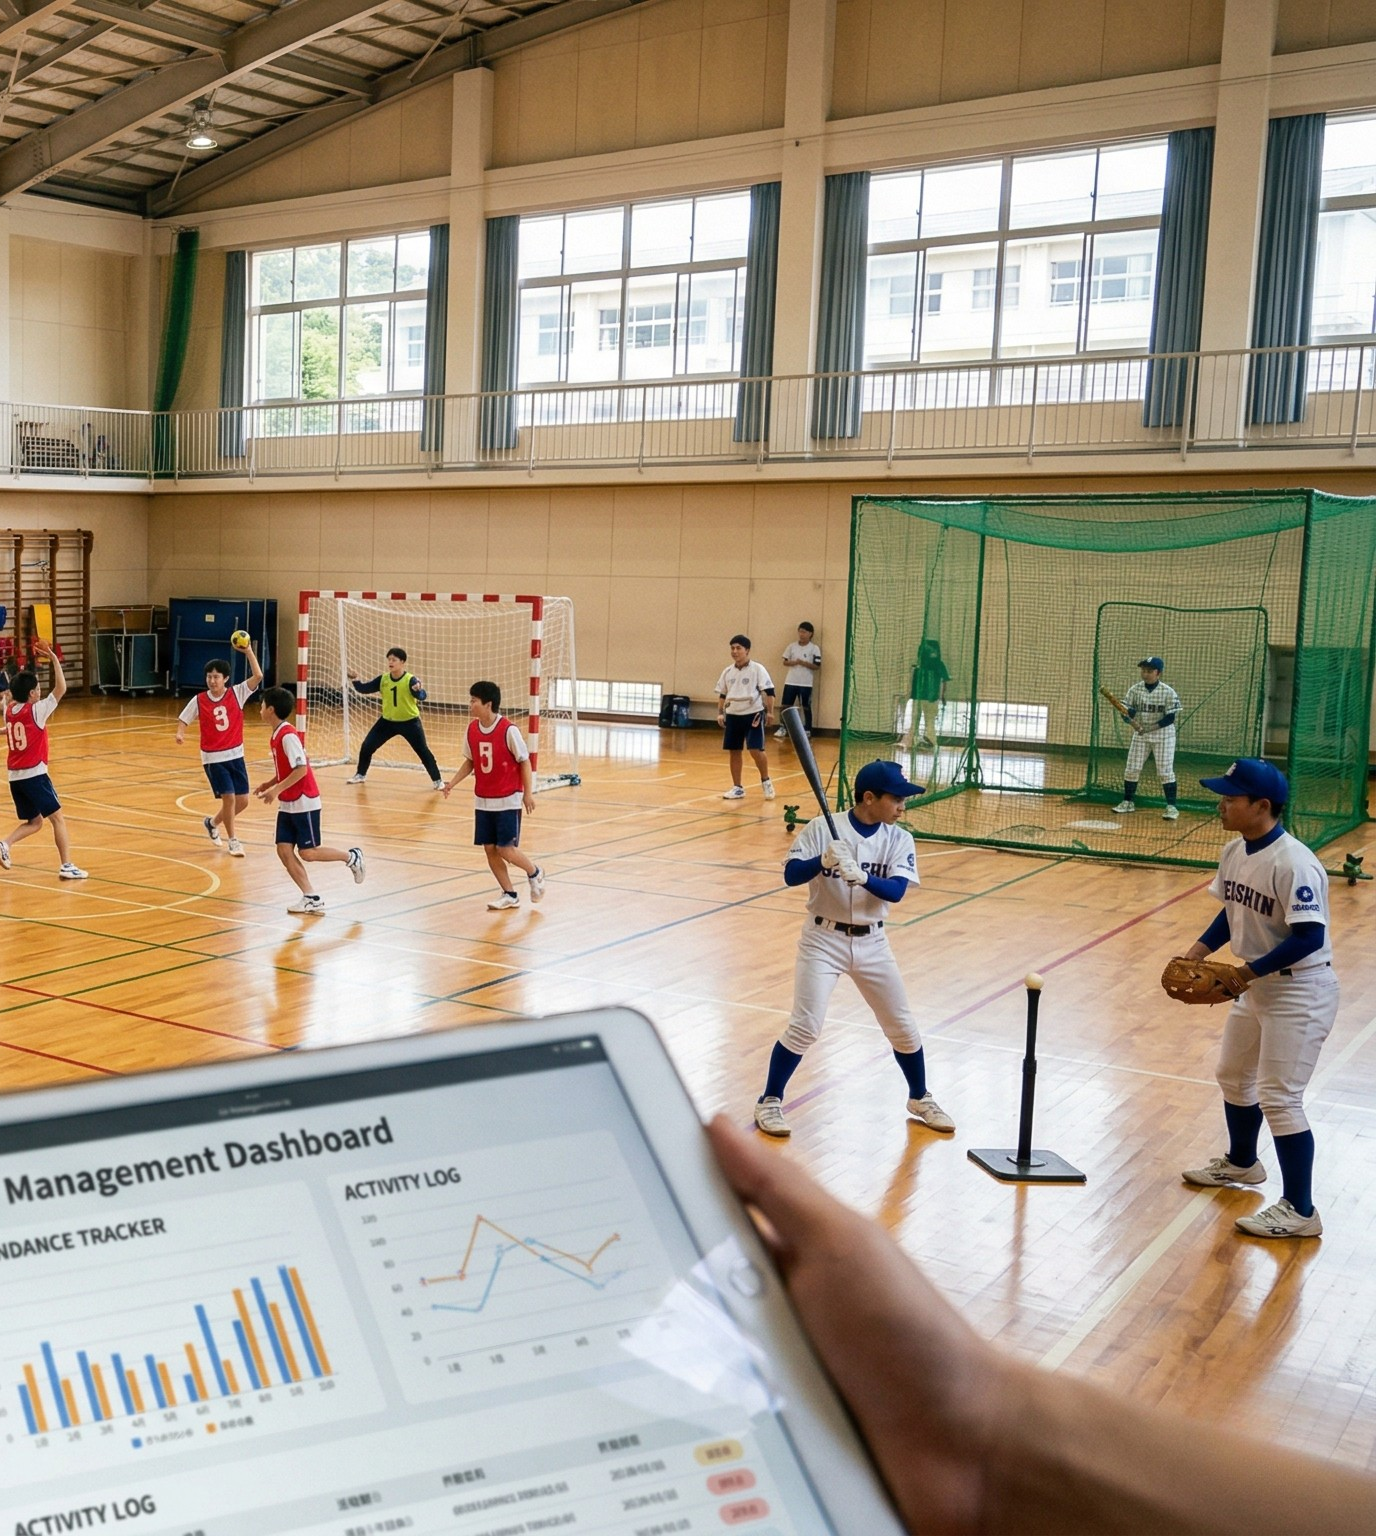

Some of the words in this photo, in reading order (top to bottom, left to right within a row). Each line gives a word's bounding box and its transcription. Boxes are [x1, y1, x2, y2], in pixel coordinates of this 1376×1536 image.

[390, 685, 398, 707] 1
[213, 705, 230, 732] 3
[7, 721, 28, 751] 19
[3, 1146, 221, 1204] Management
[223, 1116, 395, 1169] Dashboard
[344, 1174, 421, 1201] ACTIVITY
[424, 1167, 462, 1188] LOG
[77, 1217, 167, 1247] TRACKER
[14, 1504, 106, 1536] ACTIVITY
[112, 1495, 156, 1520] LOG
